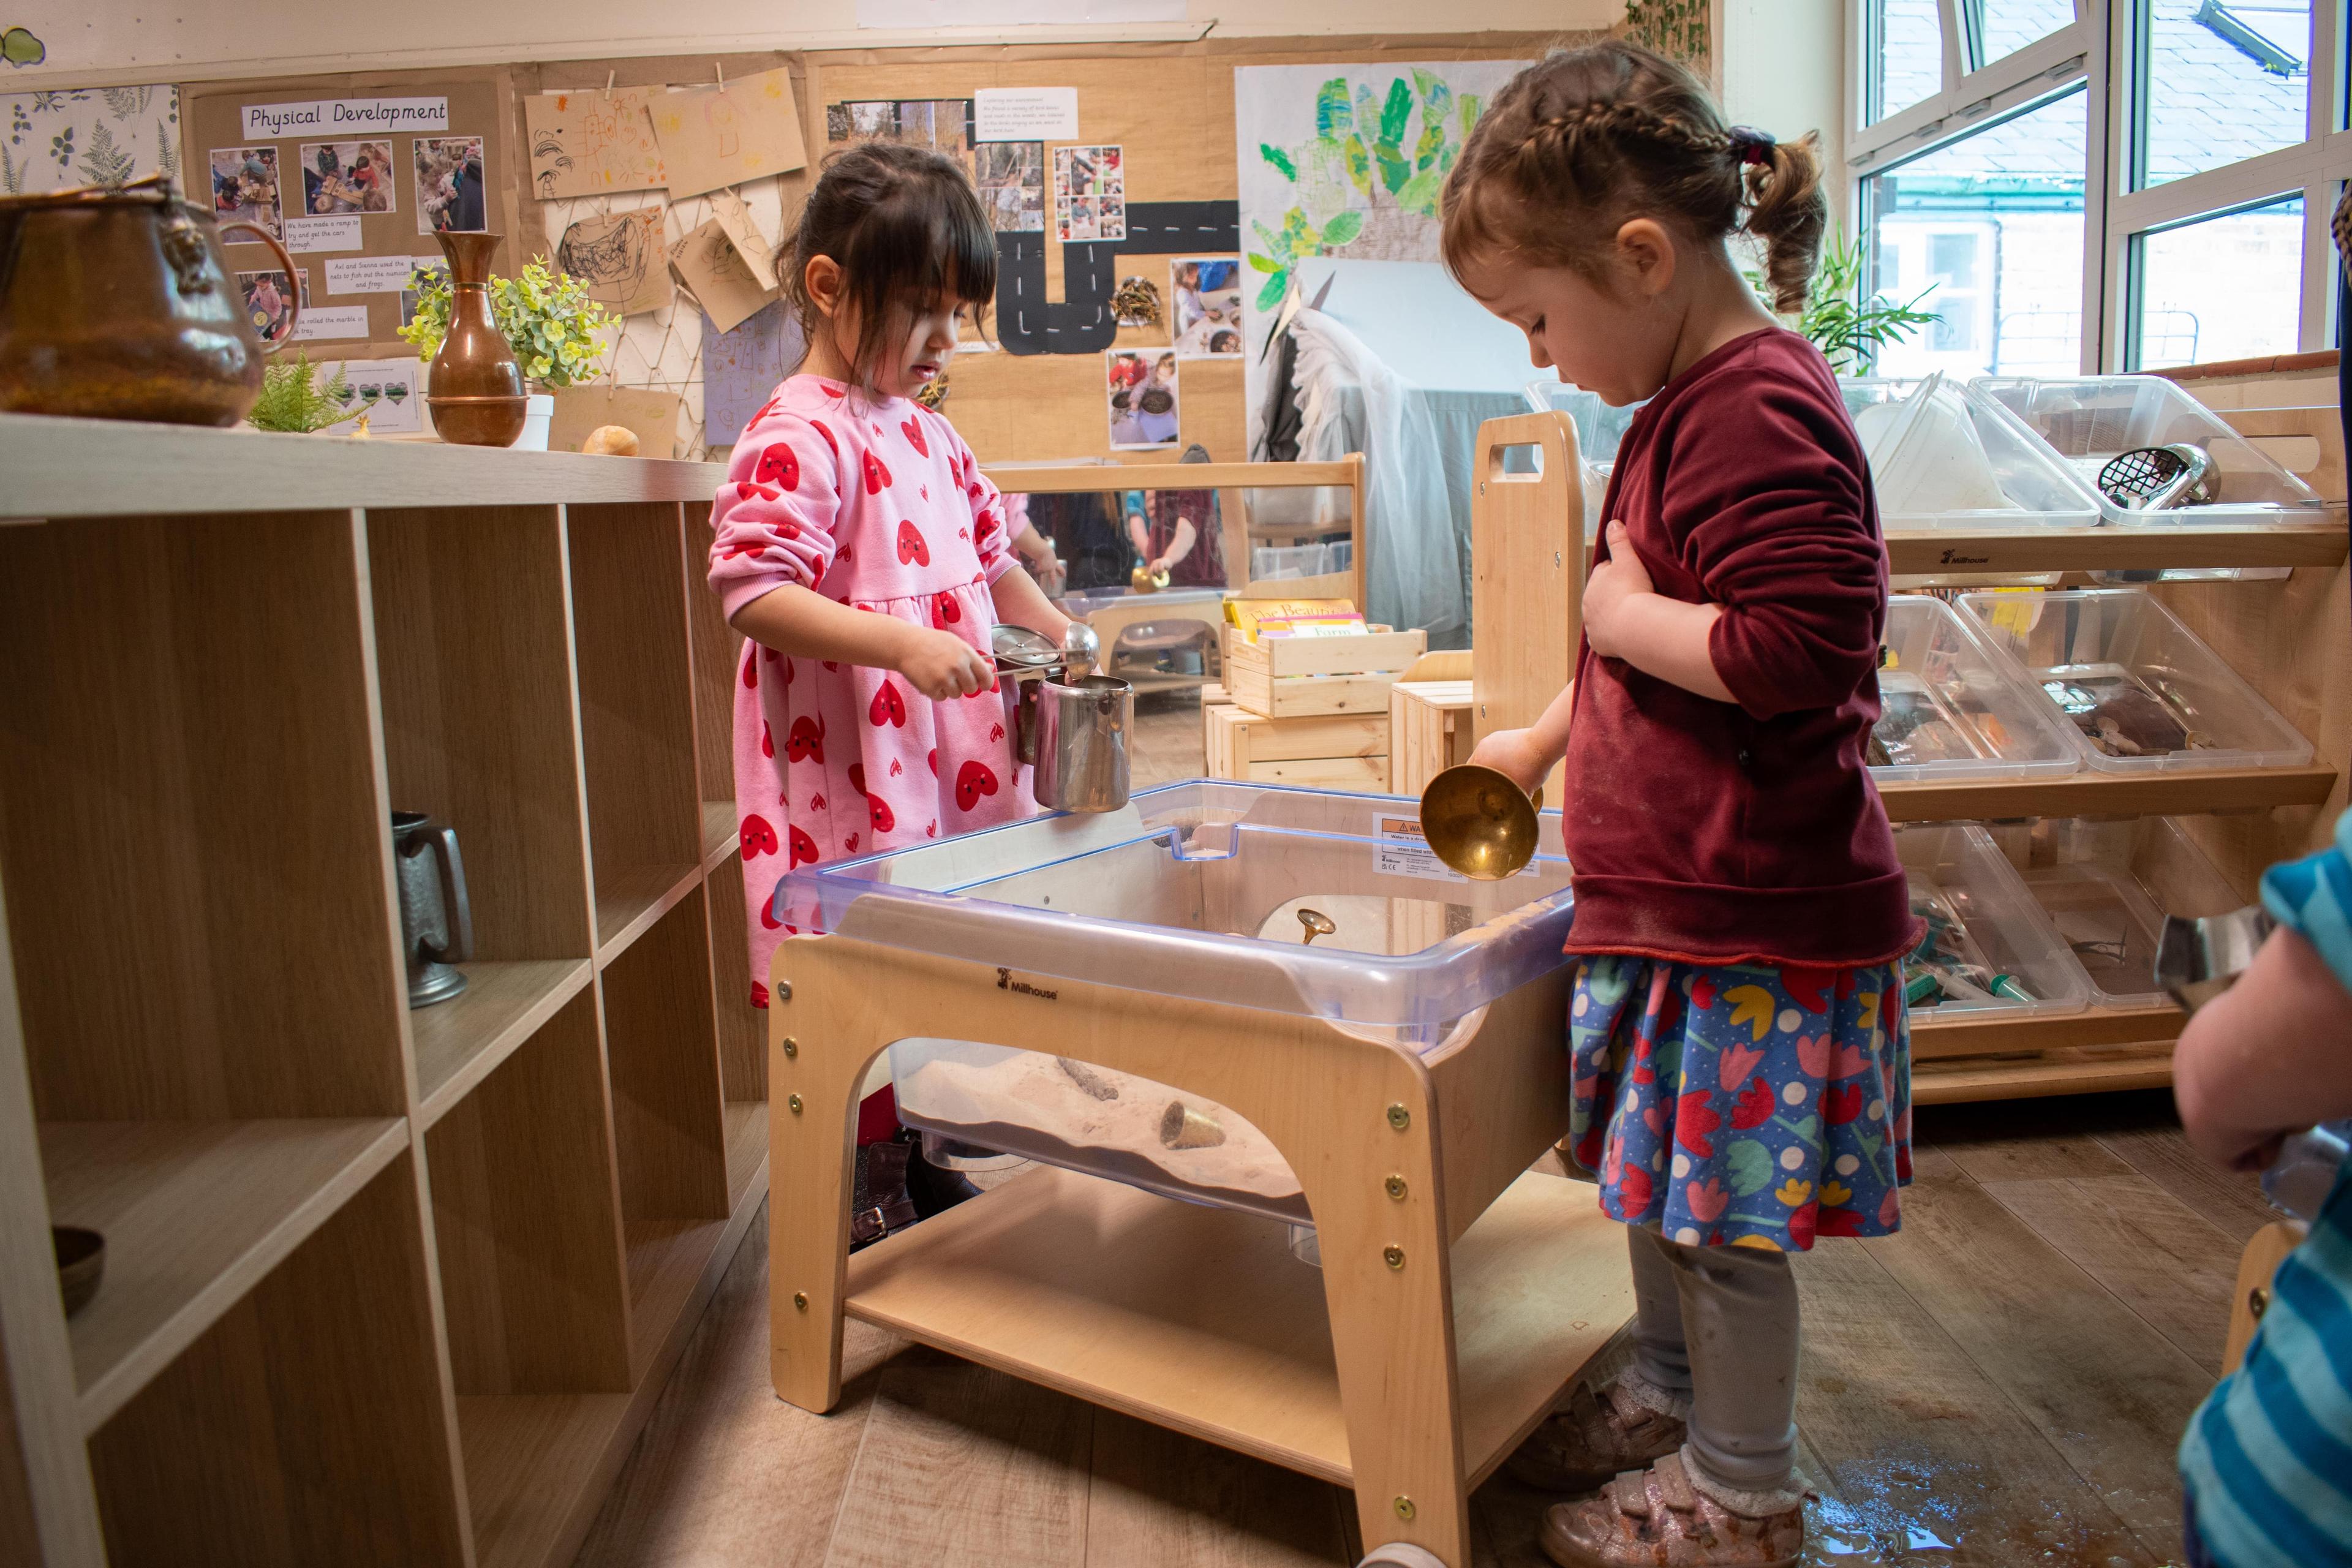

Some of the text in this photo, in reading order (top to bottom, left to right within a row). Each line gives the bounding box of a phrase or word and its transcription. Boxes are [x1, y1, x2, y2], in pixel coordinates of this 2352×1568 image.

[251, 102, 446, 135] Physical Development
[311, 231, 320, 239] get
[350, 272, 362, 281] fish
[1011, 981, 1058, 1000] Millhouse
